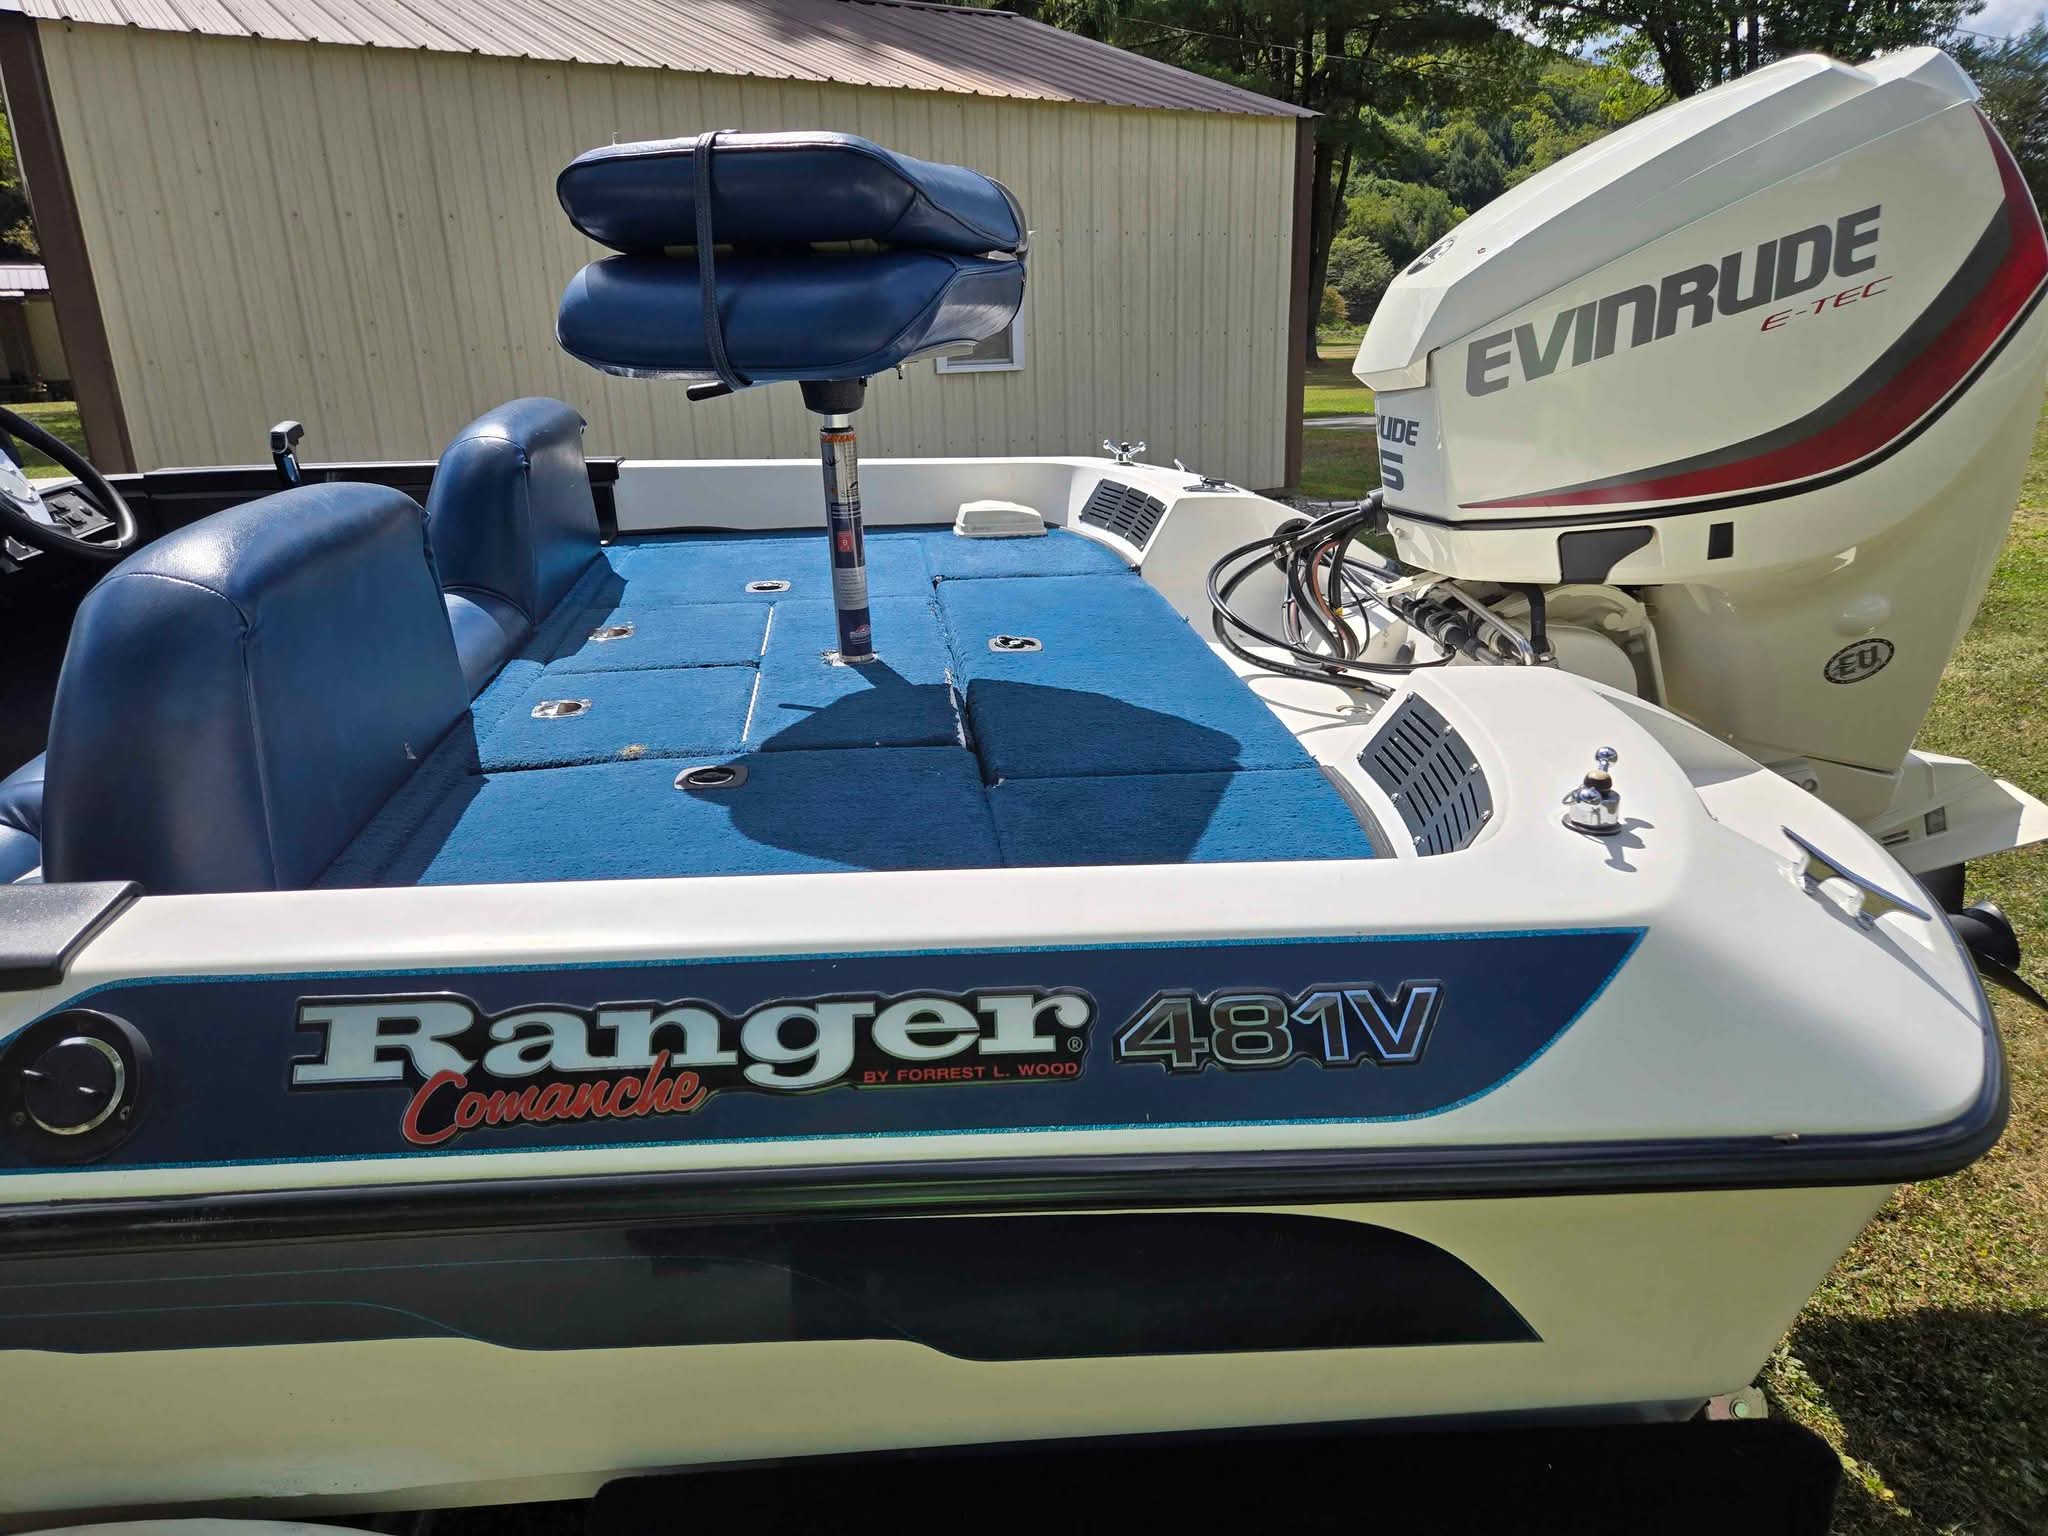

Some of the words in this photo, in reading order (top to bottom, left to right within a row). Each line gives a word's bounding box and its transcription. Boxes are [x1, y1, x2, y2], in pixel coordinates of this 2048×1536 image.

[1465, 204, 1881, 397] EVINRUDE
[1760, 275, 1894, 332] E-TEC
[1377, 414, 1420, 447] UDE
[292, 994, 1090, 1091] Ranger
[1117, 984, 1446, 1070] 481V
[402, 1048, 708, 1145] Comanche
[863, 1070, 889, 1084] BY
[897, 1065, 986, 1081] FORREST
[993, 1066, 1011, 1078] L.
[1018, 1062, 1078, 1077] WOOD
